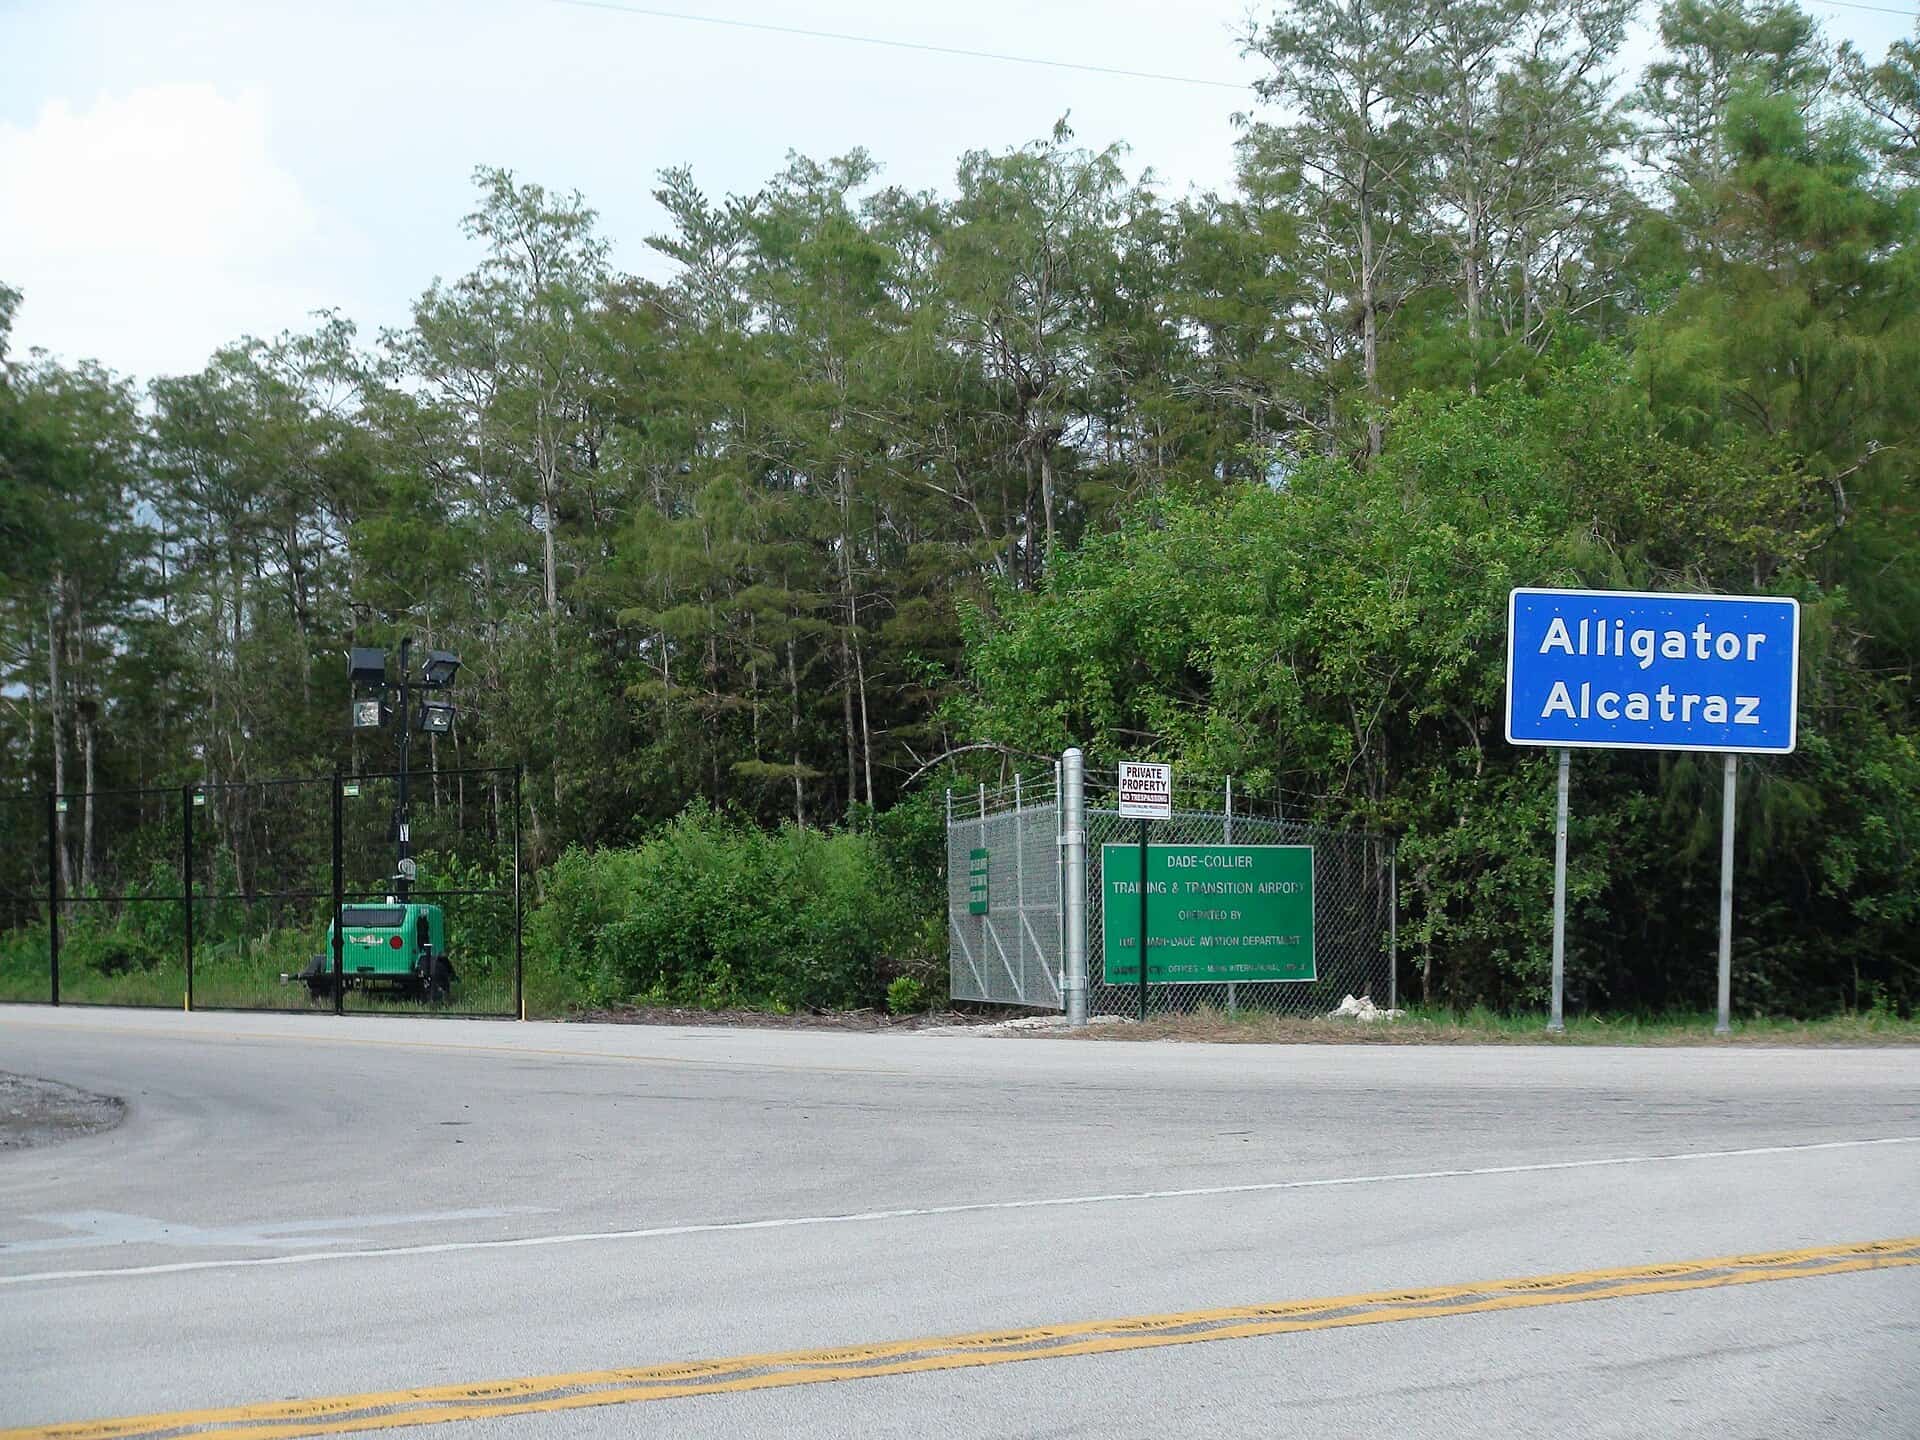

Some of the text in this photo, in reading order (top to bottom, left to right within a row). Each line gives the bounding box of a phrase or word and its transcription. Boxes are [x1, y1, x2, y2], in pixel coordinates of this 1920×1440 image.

[1539, 617, 1767, 670] Alligator
[1541, 681, 1761, 725] Alcatraz
[1127, 766, 1162, 779] PRIVATE
[1122, 779, 1167, 792] PROPERTY
[1122, 793, 1130, 801] NO
[1167, 855, 1253, 868] DADE-COLLIER
[1112, 881, 1167, 894] TRAIING
[1171, 882, 1179, 894] &
[1185, 881, 1253, 894] TRANSITION
[1230, 910, 1242, 920] BY
[1142, 936, 1195, 947] IAMI-DADE
